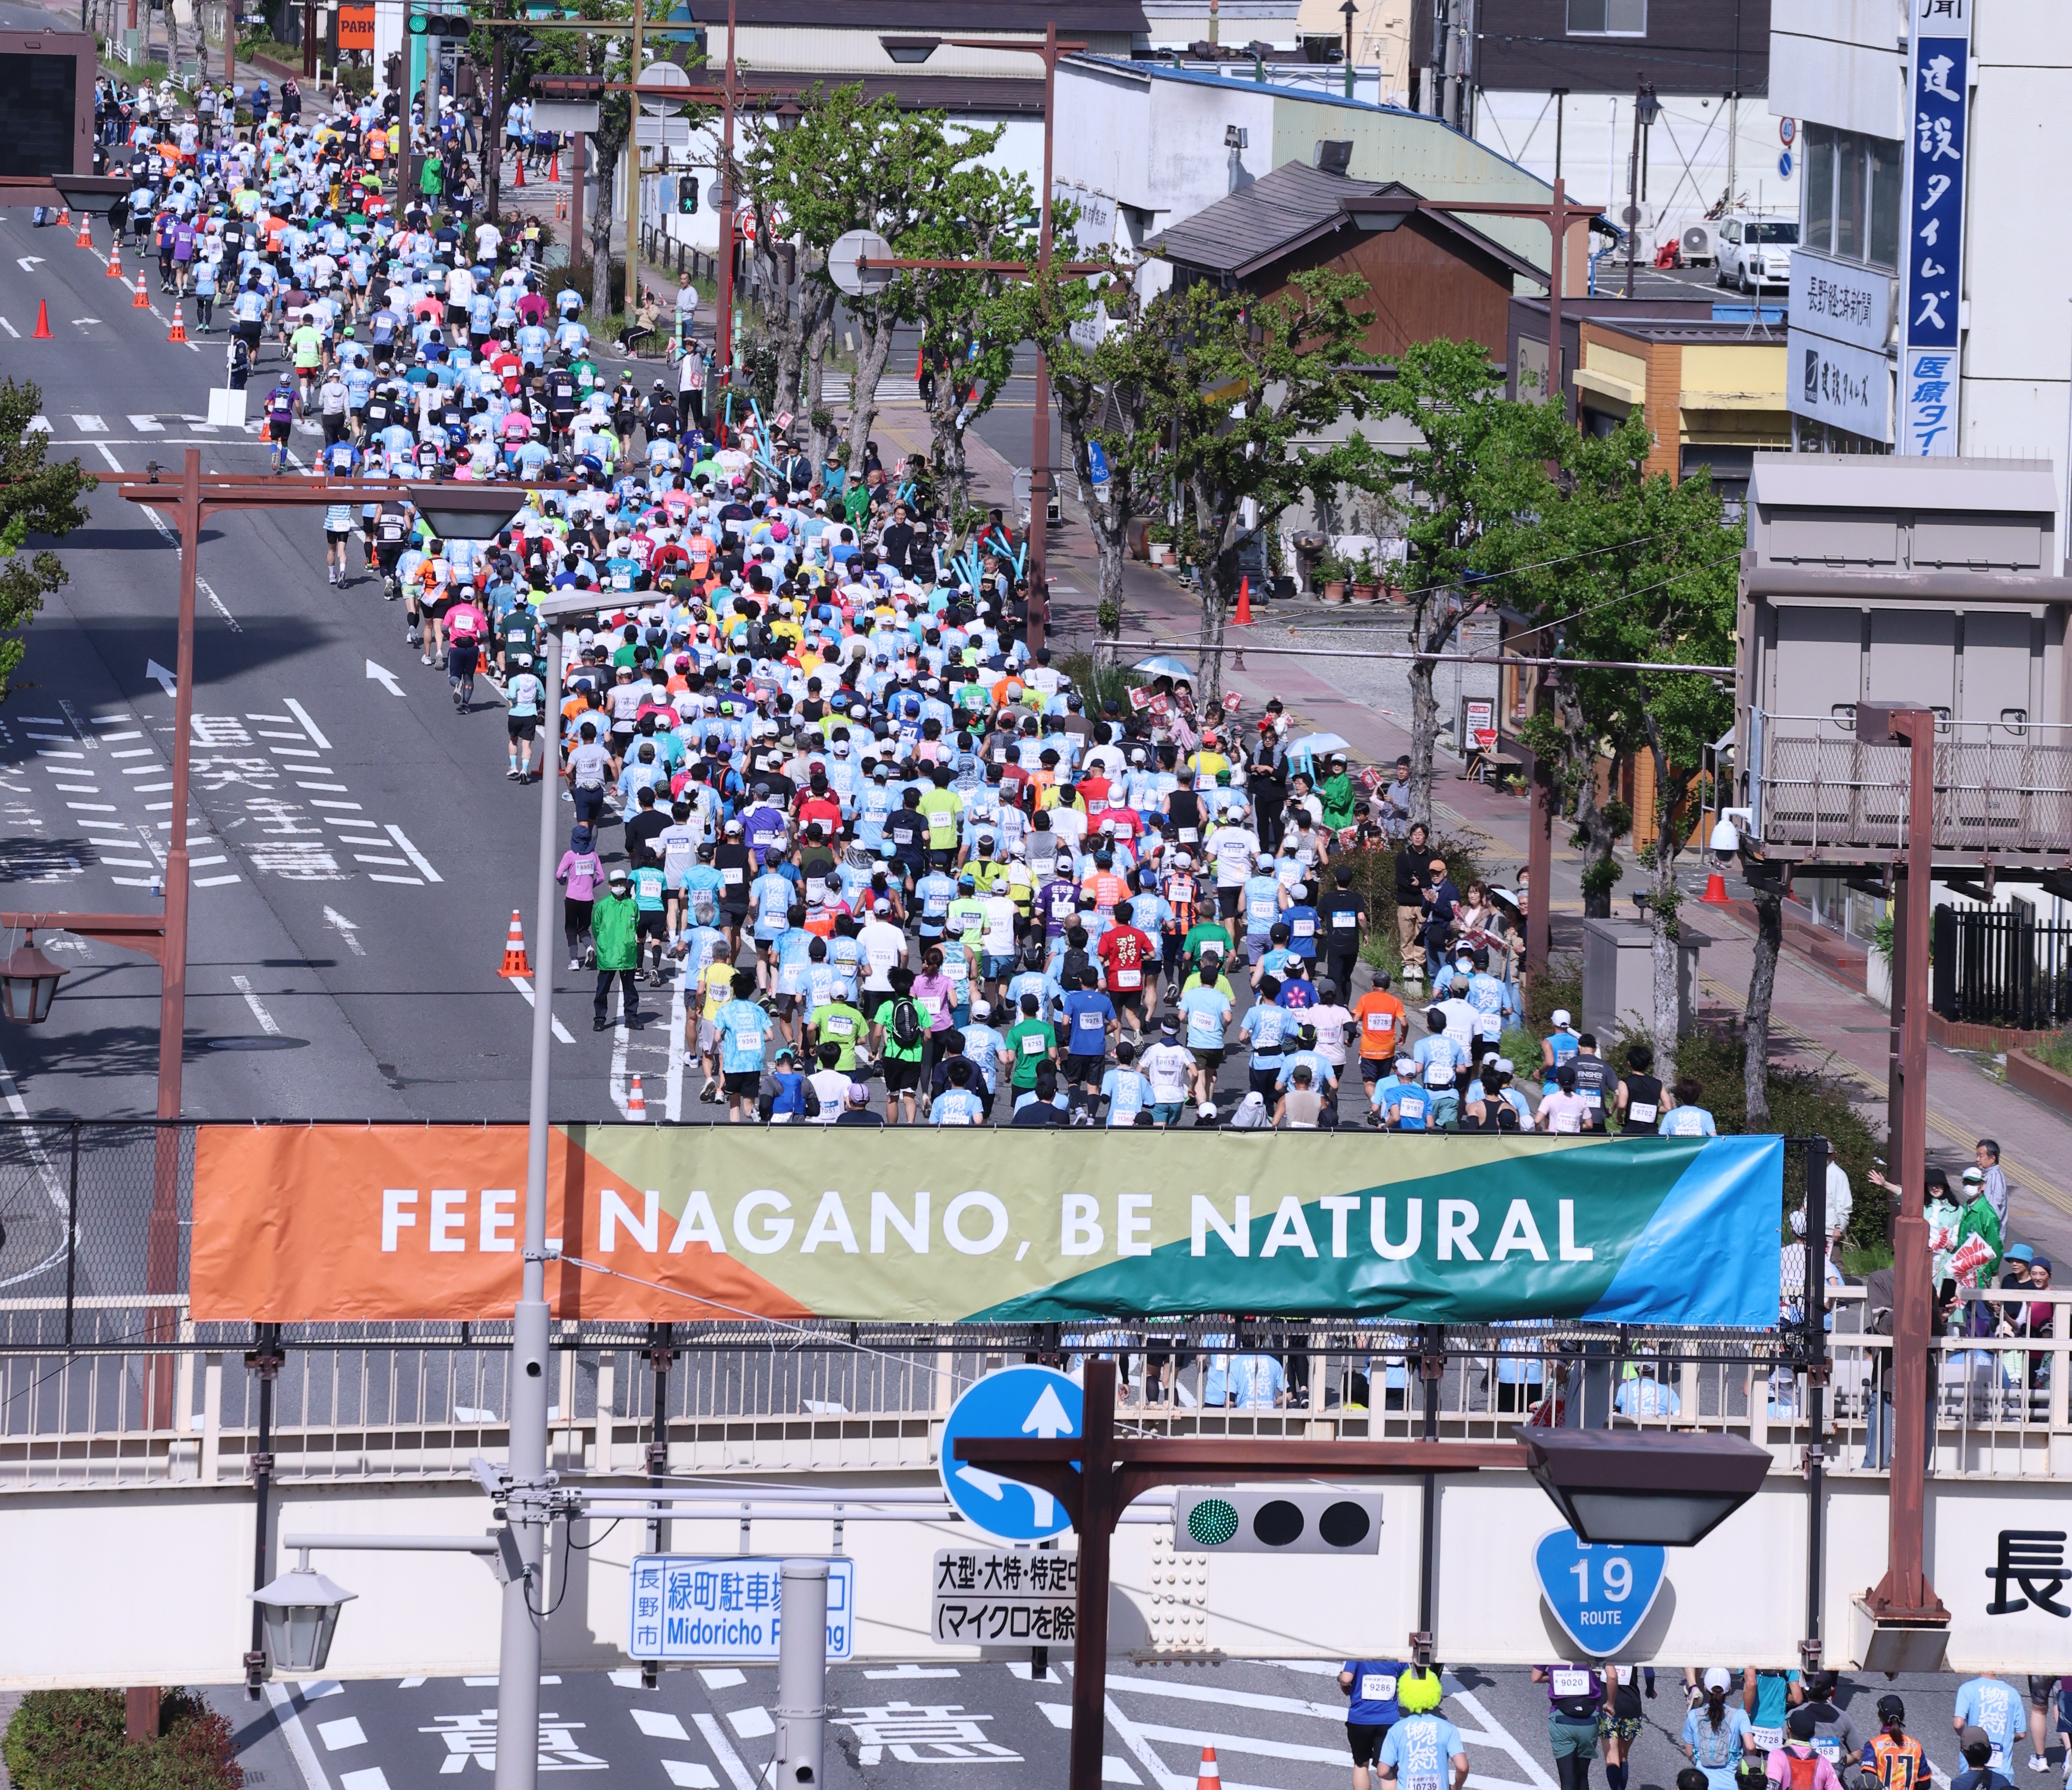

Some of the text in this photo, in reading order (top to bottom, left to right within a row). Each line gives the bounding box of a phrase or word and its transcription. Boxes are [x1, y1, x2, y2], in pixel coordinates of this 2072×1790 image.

[1783, 122, 1793, 137] 40
[1915, 54, 1961, 330] 建設タイムズ
[1807, 276, 1872, 327] 長野経済新聞
[1821, 360, 1868, 407] 建設タイムズ
[381, 1190, 1594, 1262] FEE NAGANO, BE NATURAL
[1570, 1557, 1633, 1602] 19
[1985, 1530, 2072, 1618] 長
[638, 1569, 659, 1646] 長野市
[1581, 1611, 1622, 1625] ROUTE
[667, 1617, 762, 1645] Midoricho
[1370, 1683, 1390, 1692] 9286
[1562, 1678, 1582, 1686] 9020
[1758, 1735, 1779, 1744] 7728
[1883, 1754, 1914, 1790] 17
